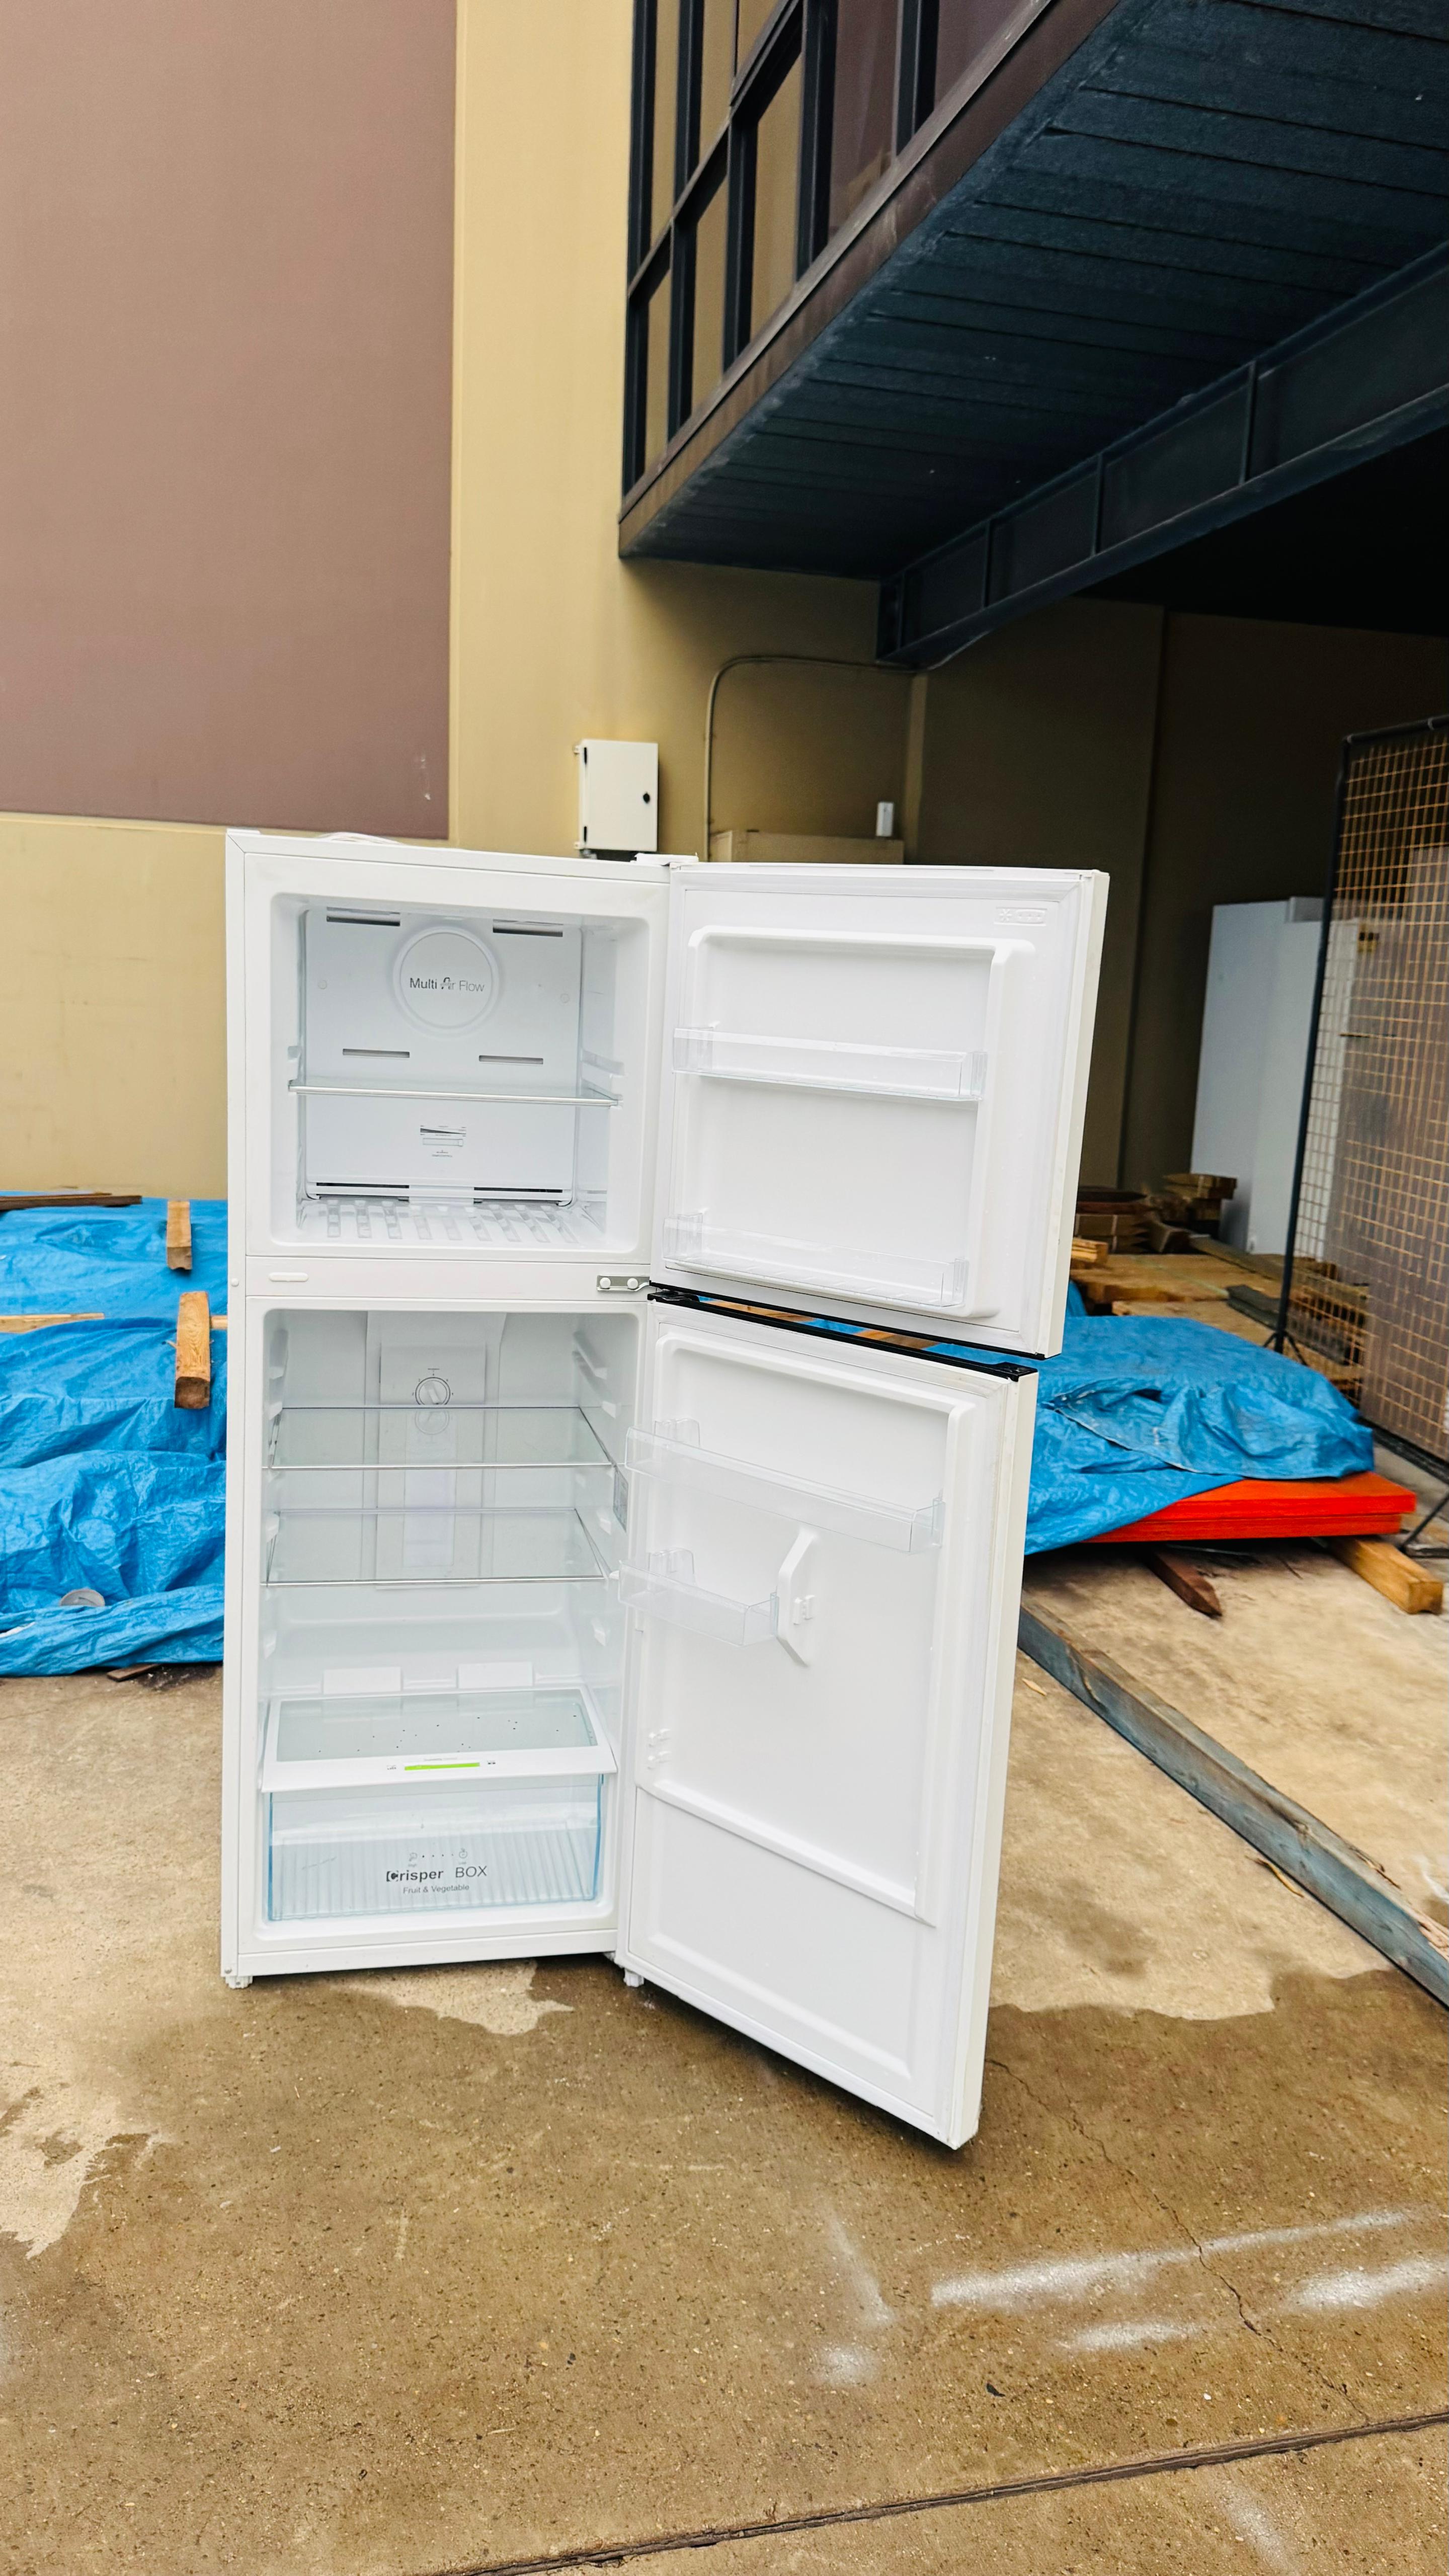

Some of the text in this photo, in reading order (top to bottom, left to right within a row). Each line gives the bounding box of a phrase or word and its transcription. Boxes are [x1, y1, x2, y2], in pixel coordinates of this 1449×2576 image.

[410, 977, 437, 989] Multi
[459, 980, 485, 992] Flow
[386, 1866, 487, 1883] Crisper BOX
[403, 1886, 421, 1894] Fruit
[431, 1884, 469, 1894] Vegetable
